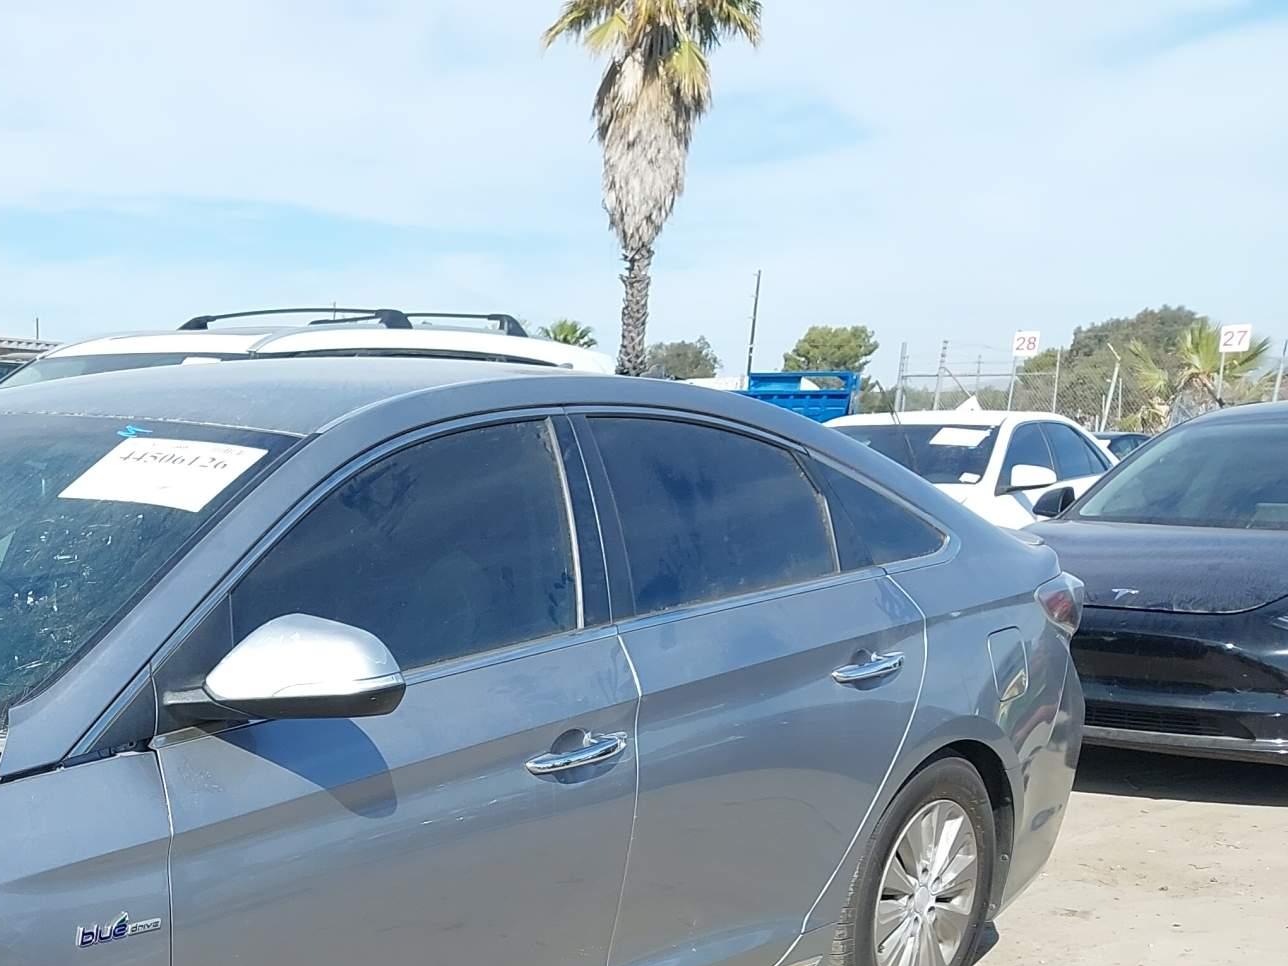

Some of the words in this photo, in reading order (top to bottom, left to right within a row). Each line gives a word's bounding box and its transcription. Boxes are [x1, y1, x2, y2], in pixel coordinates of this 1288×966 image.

[1015, 336, 1037, 351] 28
[1223, 330, 1249, 347] 27
[120, 451, 228, 470] 44506126
[76, 921, 128, 948] blue
[129, 920, 161, 935] drive
